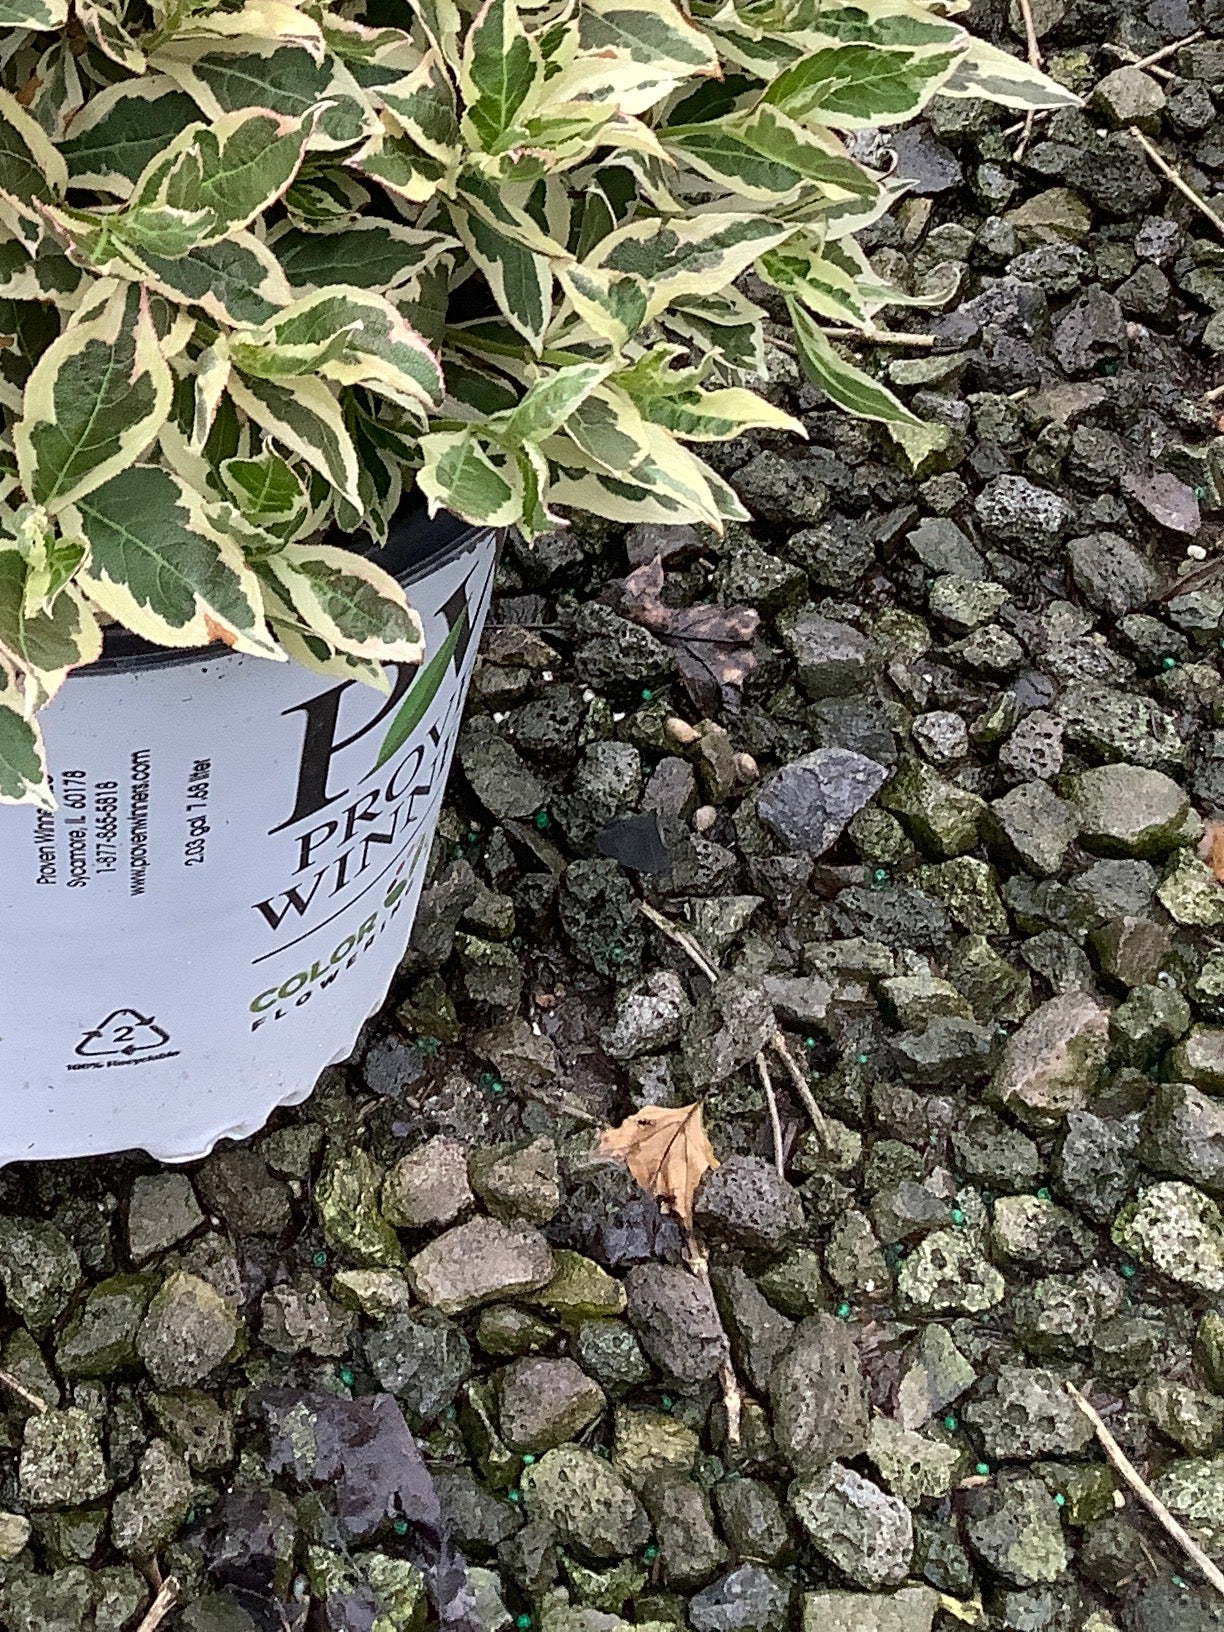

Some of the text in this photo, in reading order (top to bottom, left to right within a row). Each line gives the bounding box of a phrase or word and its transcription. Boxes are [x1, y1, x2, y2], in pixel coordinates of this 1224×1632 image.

[61, 770, 87, 810] 60178
[94, 780, 119, 874] 1-877-865-5818
[126, 749, 151, 897] www.provenwinners.com
[184, 757, 212, 867] 2.03 gal 7.68 liter
[33, 808, 58, 885] Proven Winne
[66, 826, 91, 888] Sycamore,
[249, 911, 379, 1013] COLOR
[113, 1025, 136, 1043] 2
